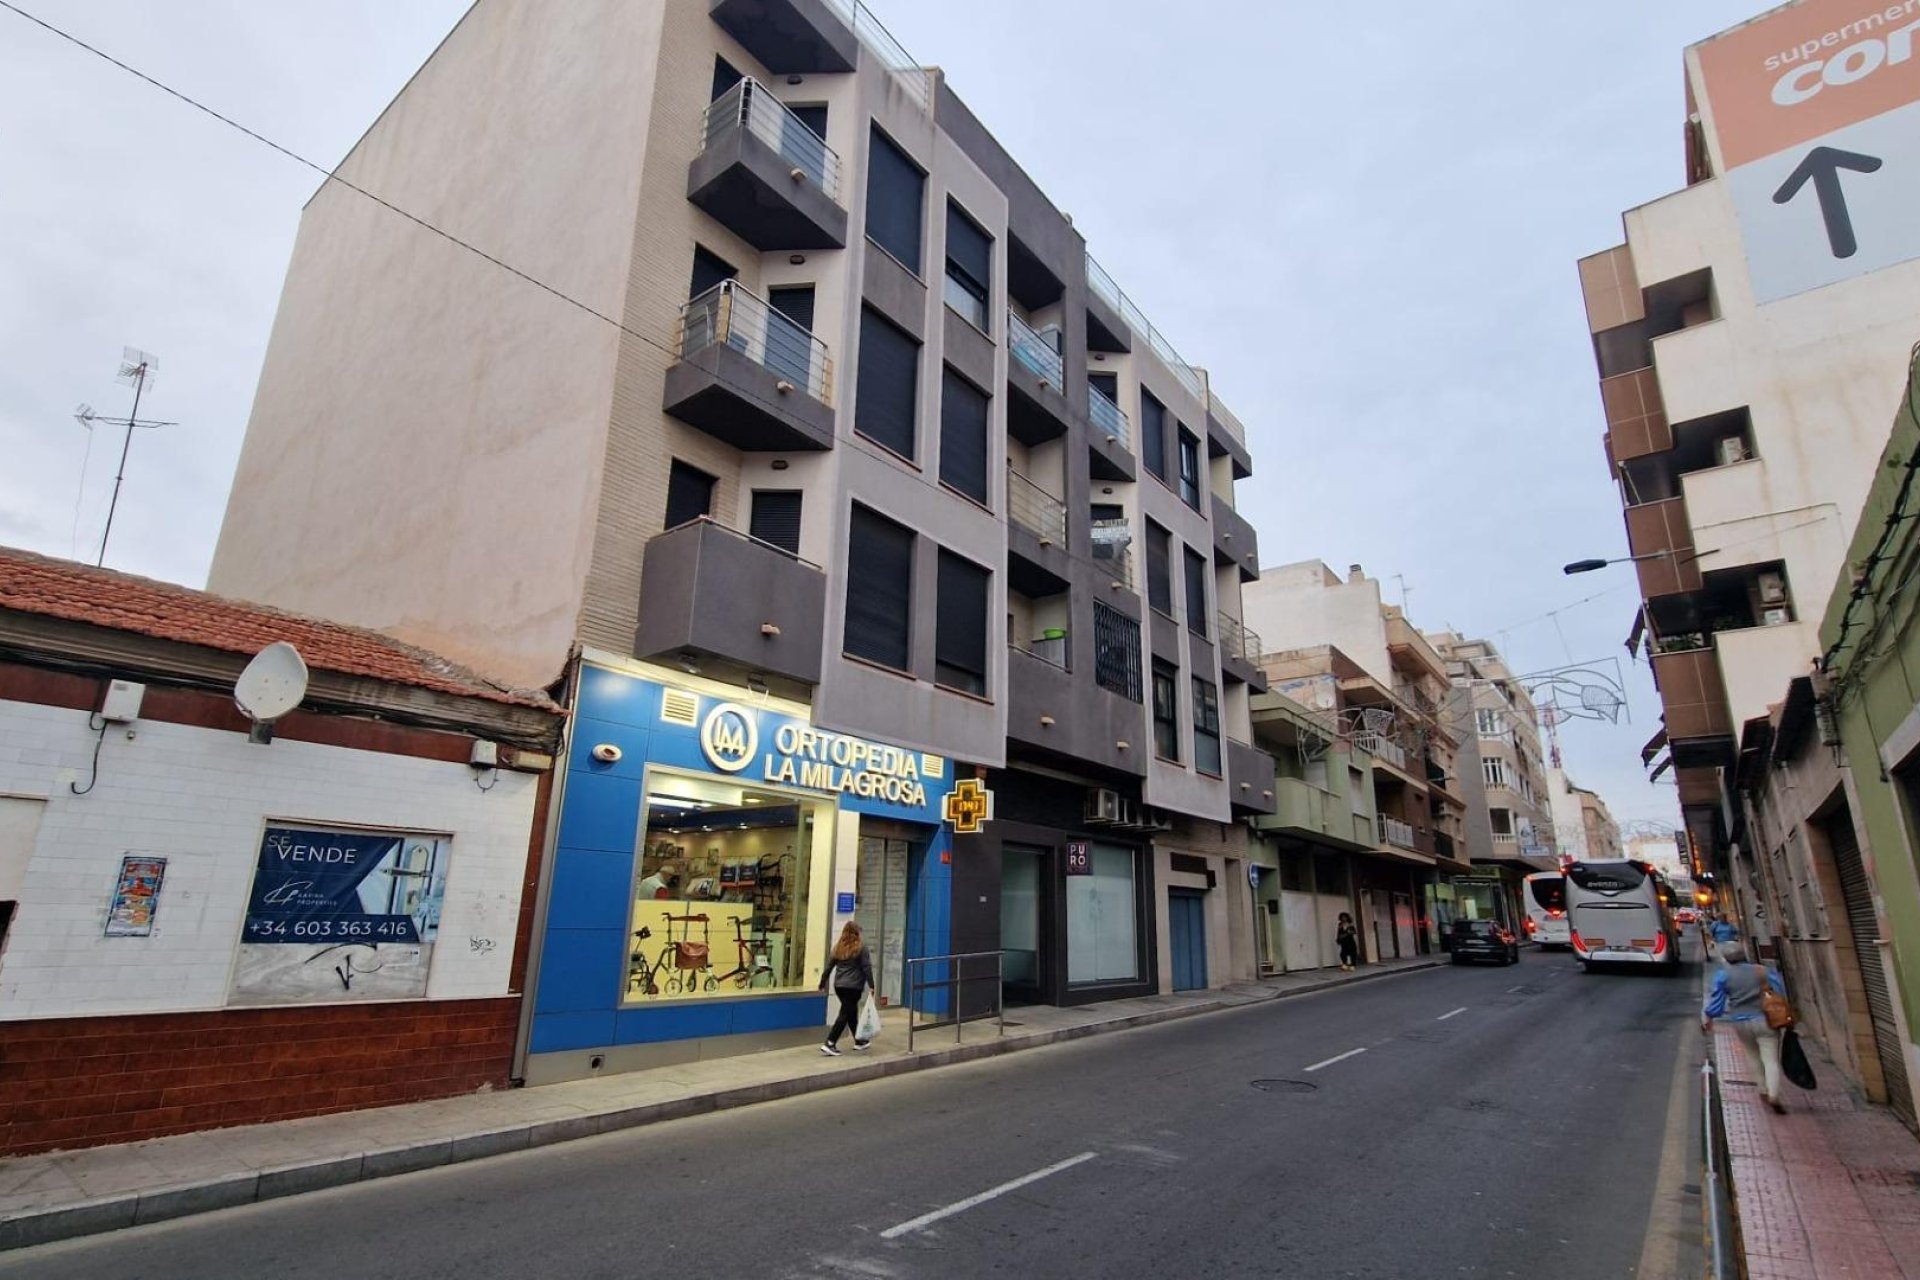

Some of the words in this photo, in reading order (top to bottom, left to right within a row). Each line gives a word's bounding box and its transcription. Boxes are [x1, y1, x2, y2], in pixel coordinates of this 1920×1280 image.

[1763, 0, 1920, 72] supermer
[775, 723, 919, 781] ORTOPEDIA
[764, 754, 798, 785] LA
[801, 760, 927, 807] MILAGROSA
[267, 834, 291, 849] SE
[277, 844, 358, 864] VENDE
[250, 920, 287, 936] +34
[294, 920, 331, 936] 603
[337, 921, 371, 936] 363
[377, 921, 407, 936] 416
